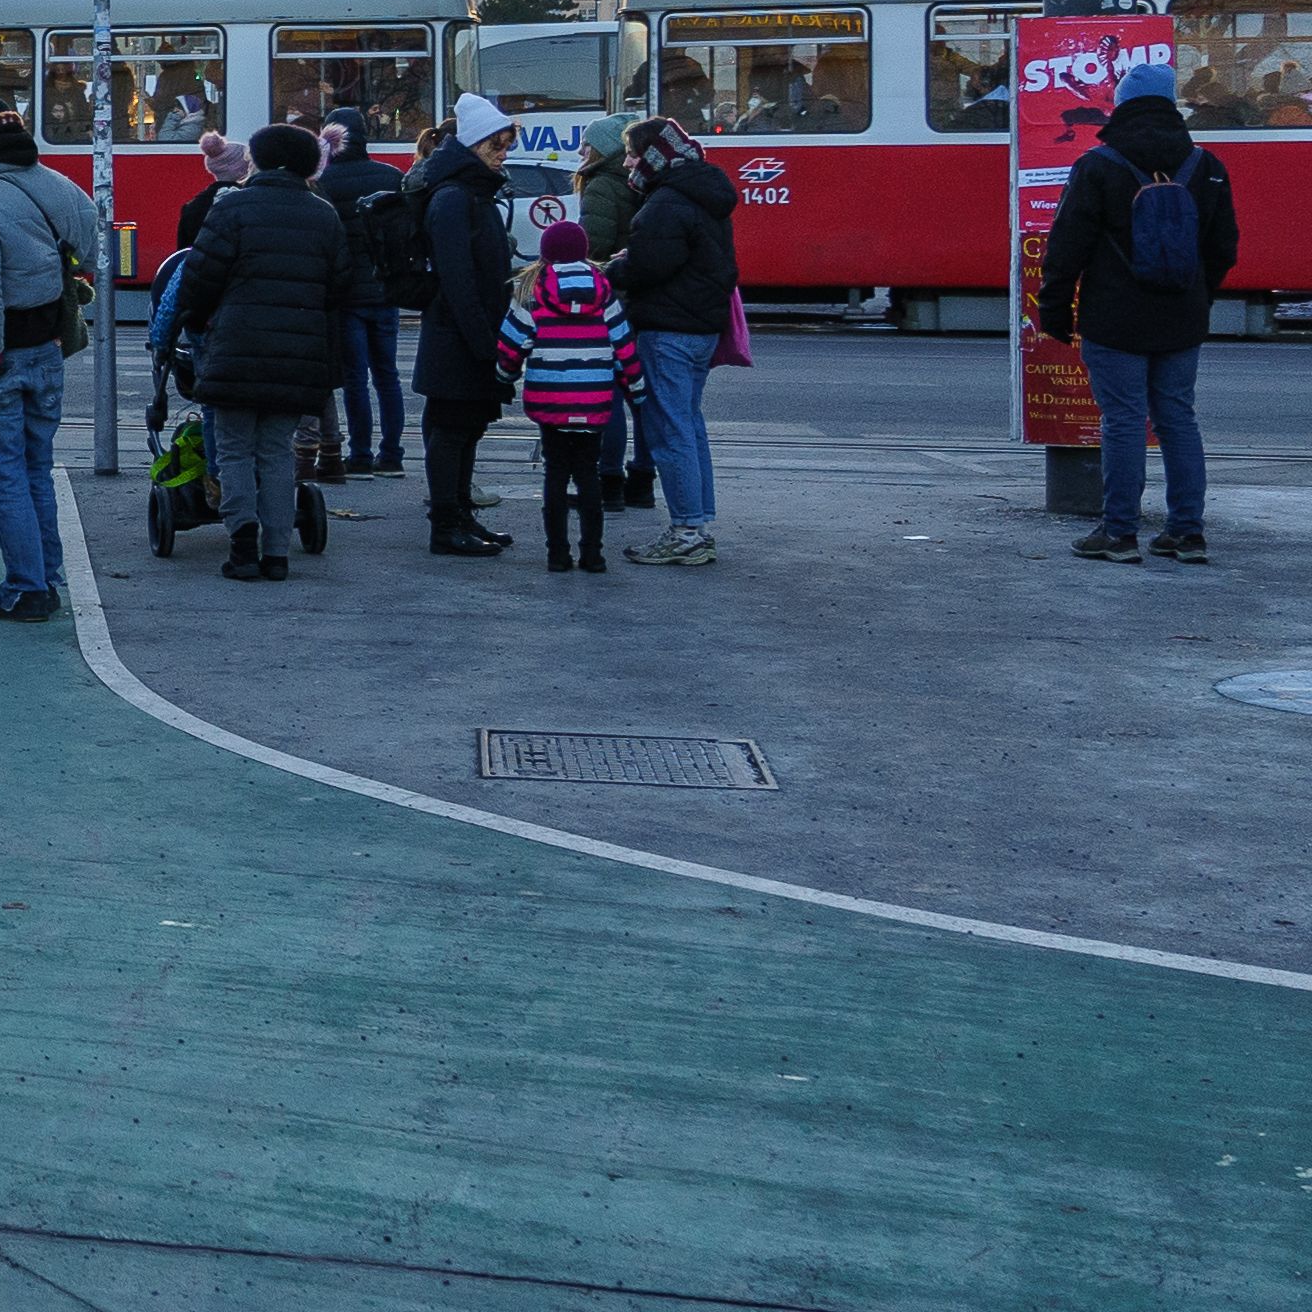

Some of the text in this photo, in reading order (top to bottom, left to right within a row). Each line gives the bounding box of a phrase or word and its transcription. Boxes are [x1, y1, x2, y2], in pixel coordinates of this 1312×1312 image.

[1024, 43, 1172, 93] STOMP
[741, 187, 790, 204] 1402
[1025, 364, 1082, 375] CAPPELLA
